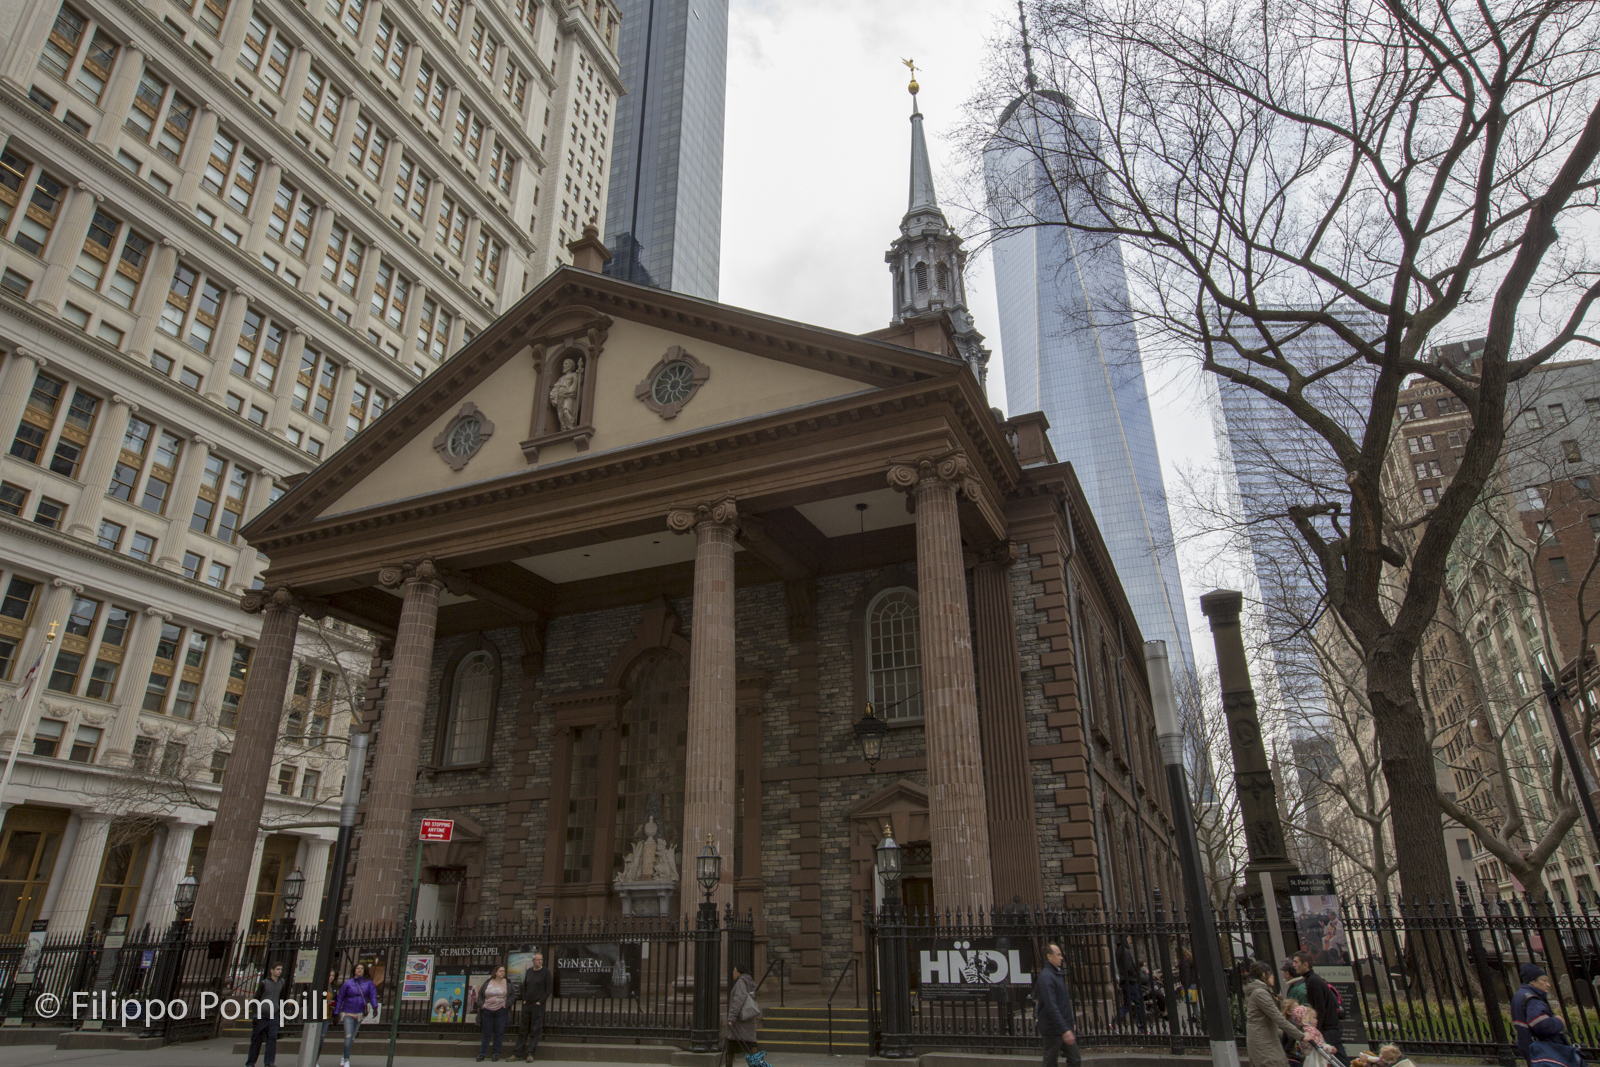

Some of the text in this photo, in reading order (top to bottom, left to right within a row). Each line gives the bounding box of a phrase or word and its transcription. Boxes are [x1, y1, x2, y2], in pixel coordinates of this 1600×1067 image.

[1312, 878, 1331, 886] Chapel
[439, 948, 449, 956] ST.
[449, 947, 471, 956] PAUL'S
[471, 947, 500, 956] CHAPEL
